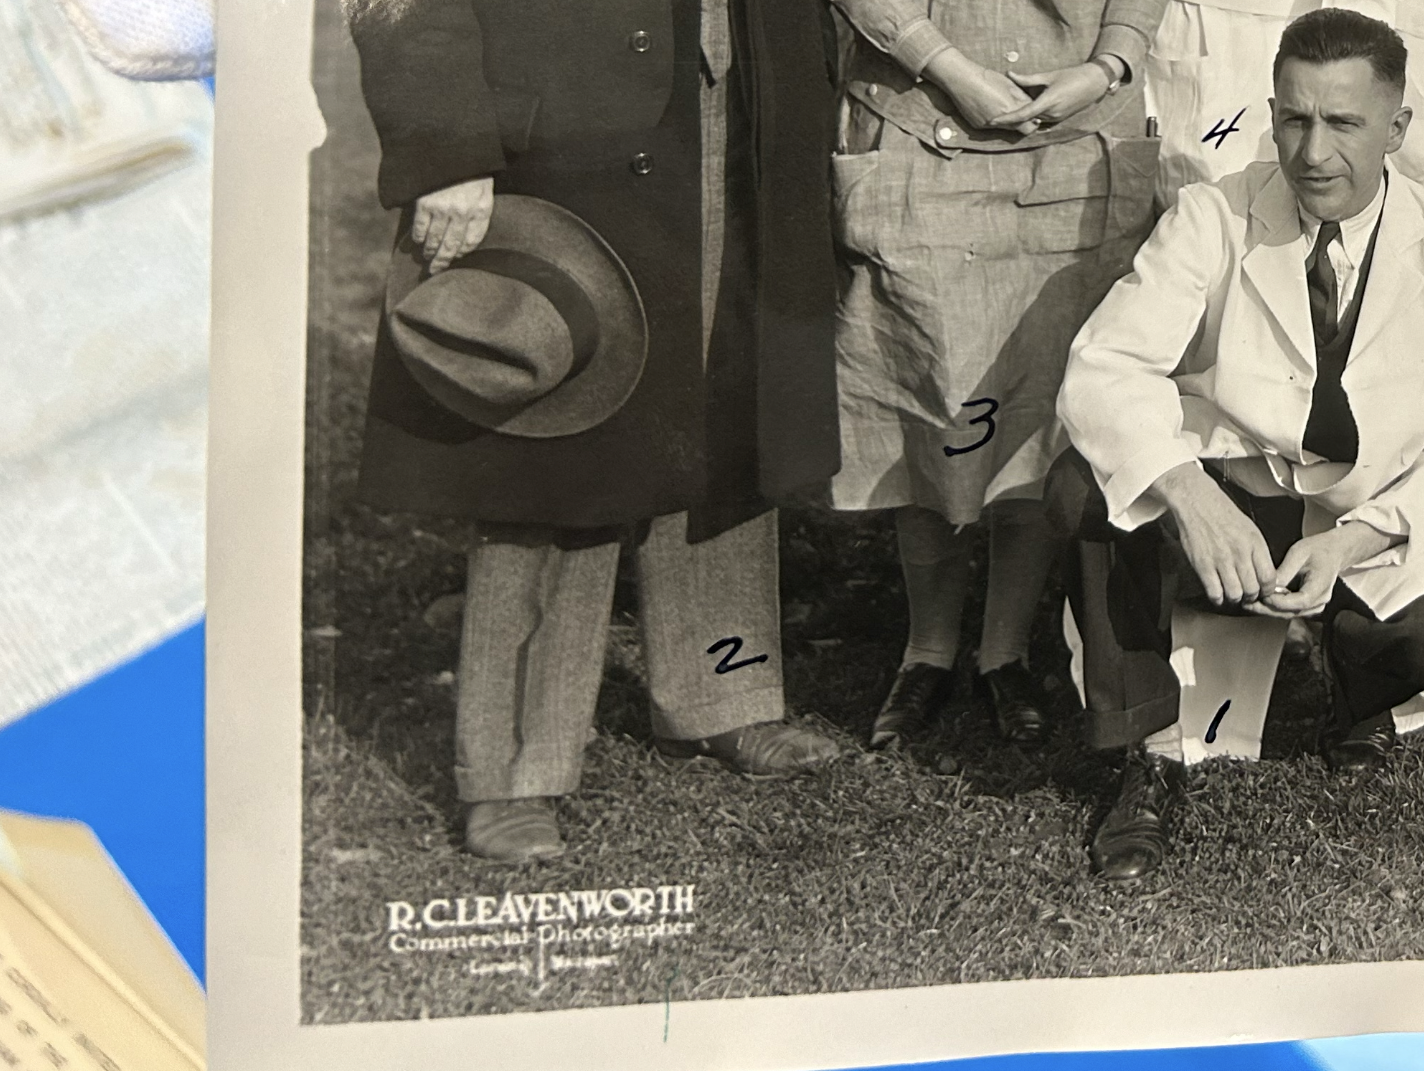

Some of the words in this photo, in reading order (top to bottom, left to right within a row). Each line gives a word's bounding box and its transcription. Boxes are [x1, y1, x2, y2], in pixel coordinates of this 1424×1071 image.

[1202, 108, 1247, 150] 4
[943, 397, 999, 457] 3
[706, 635, 770, 675] 2
[1204, 699, 1233, 744] 1
[389, 925, 529, 954] Commercial
[535, 918, 696, 979] Photographer
